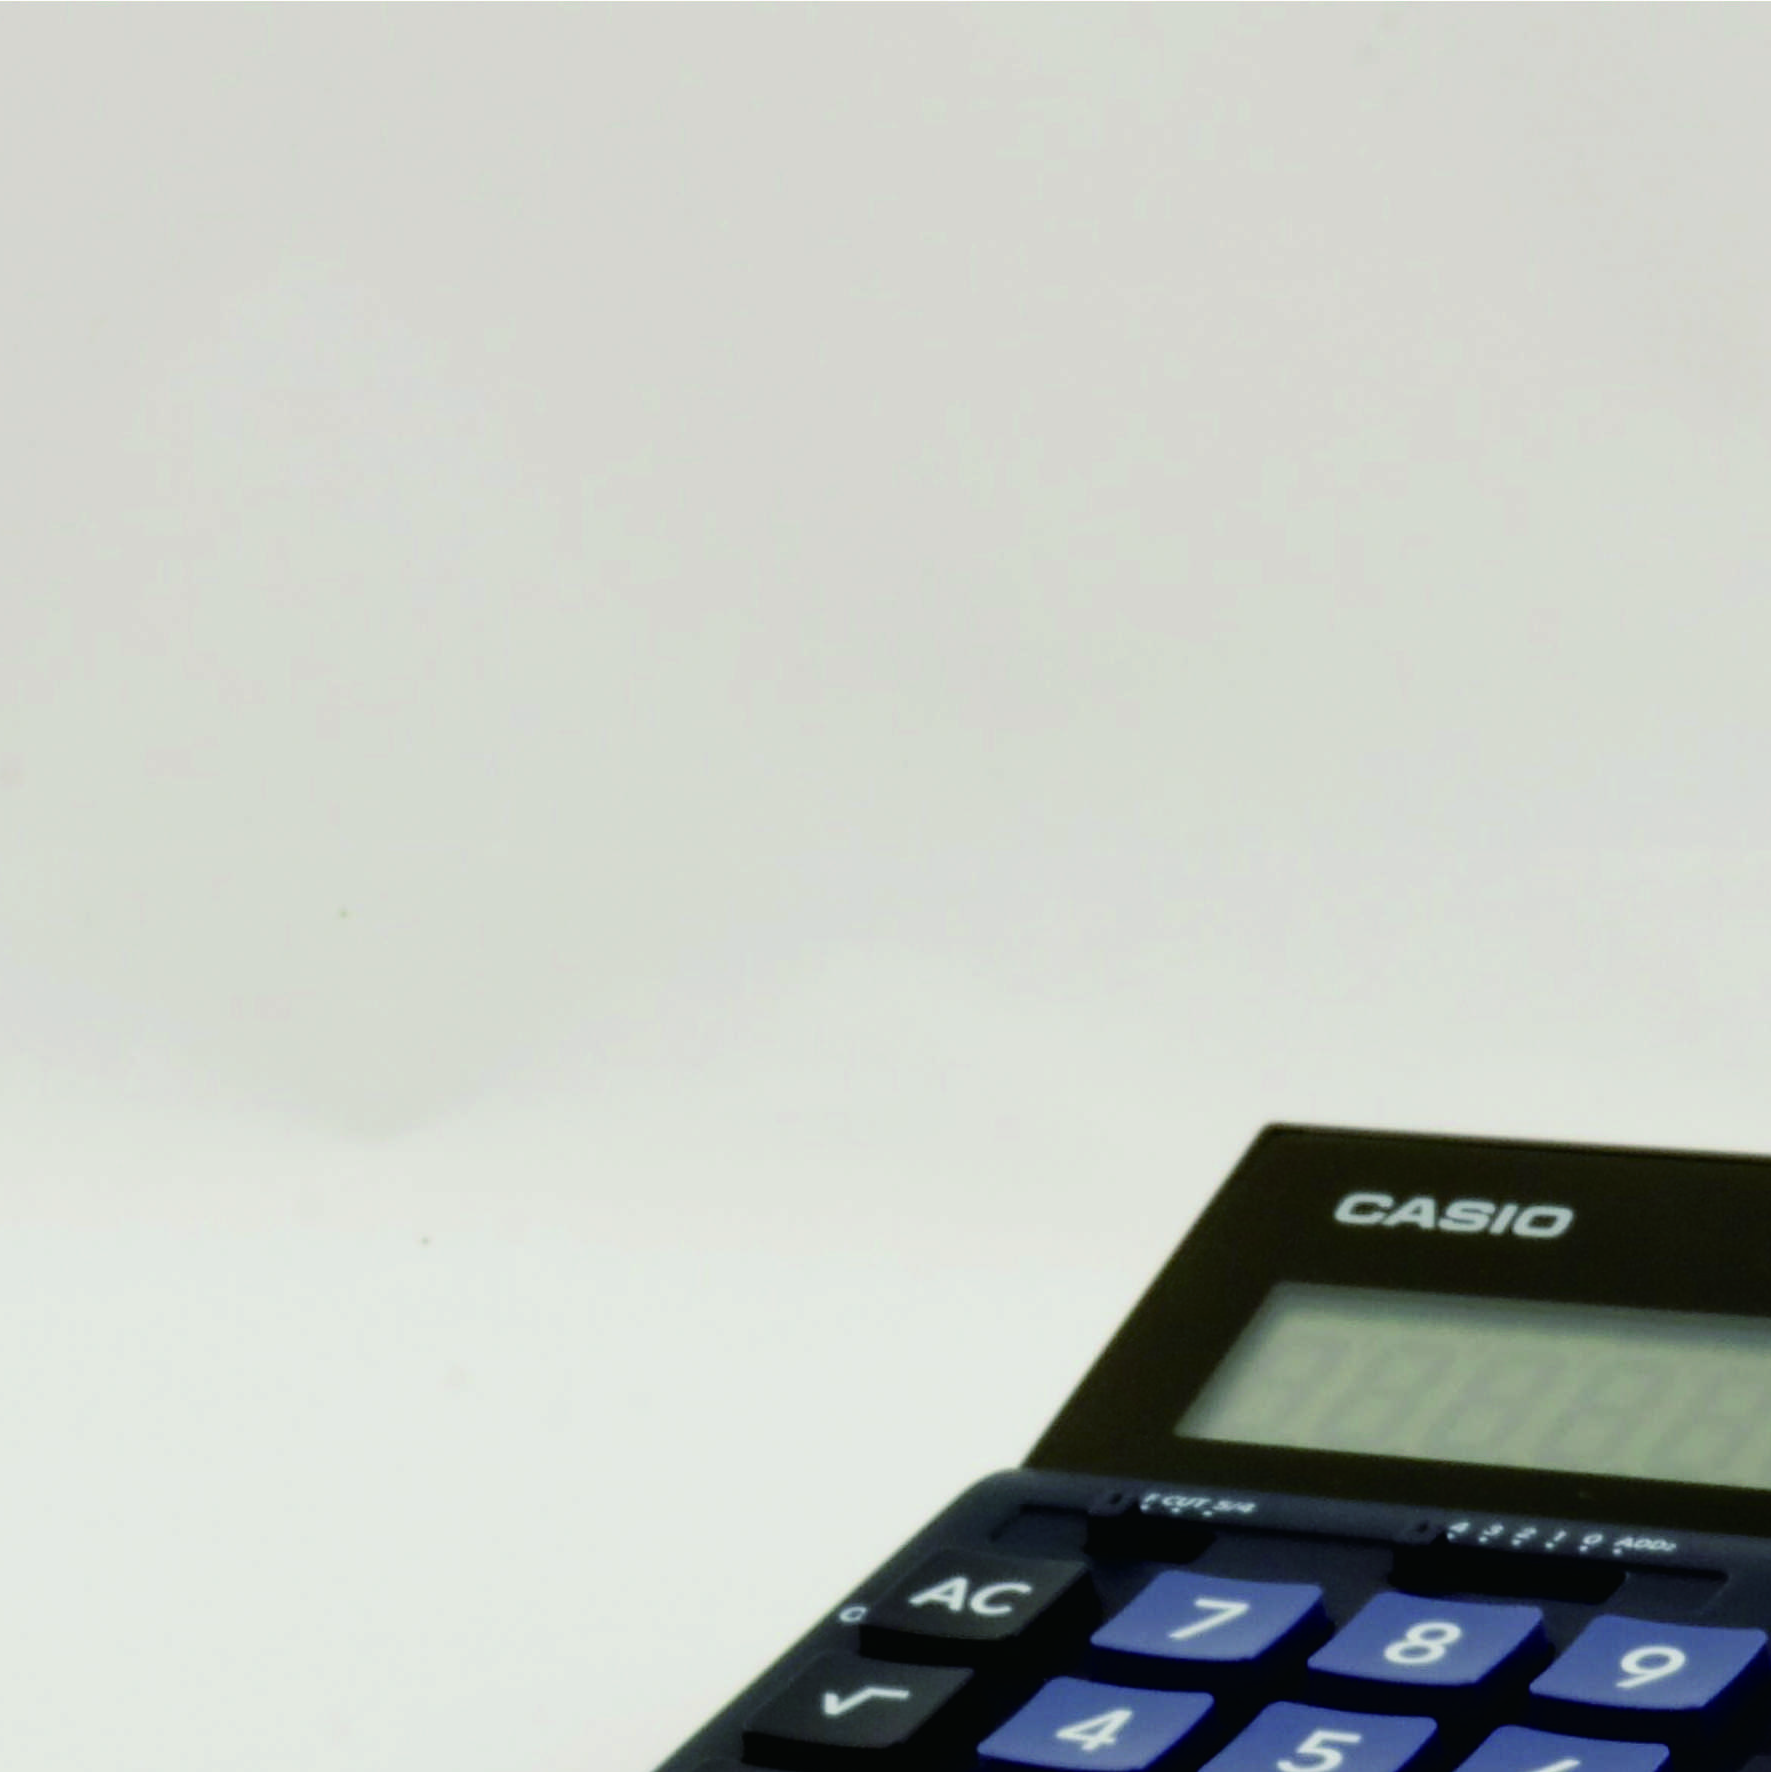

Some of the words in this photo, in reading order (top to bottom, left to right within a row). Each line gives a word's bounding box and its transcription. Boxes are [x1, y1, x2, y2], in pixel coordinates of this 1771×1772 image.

[1335, 1193, 1573, 1238] CASIO
[910, 1577, 1032, 1616] AC
[1169, 1598, 1249, 1640] 7
[1384, 1622, 1461, 1665] 8
[1617, 1646, 1685, 1688] 9
[1057, 1709, 1132, 1752] 4
